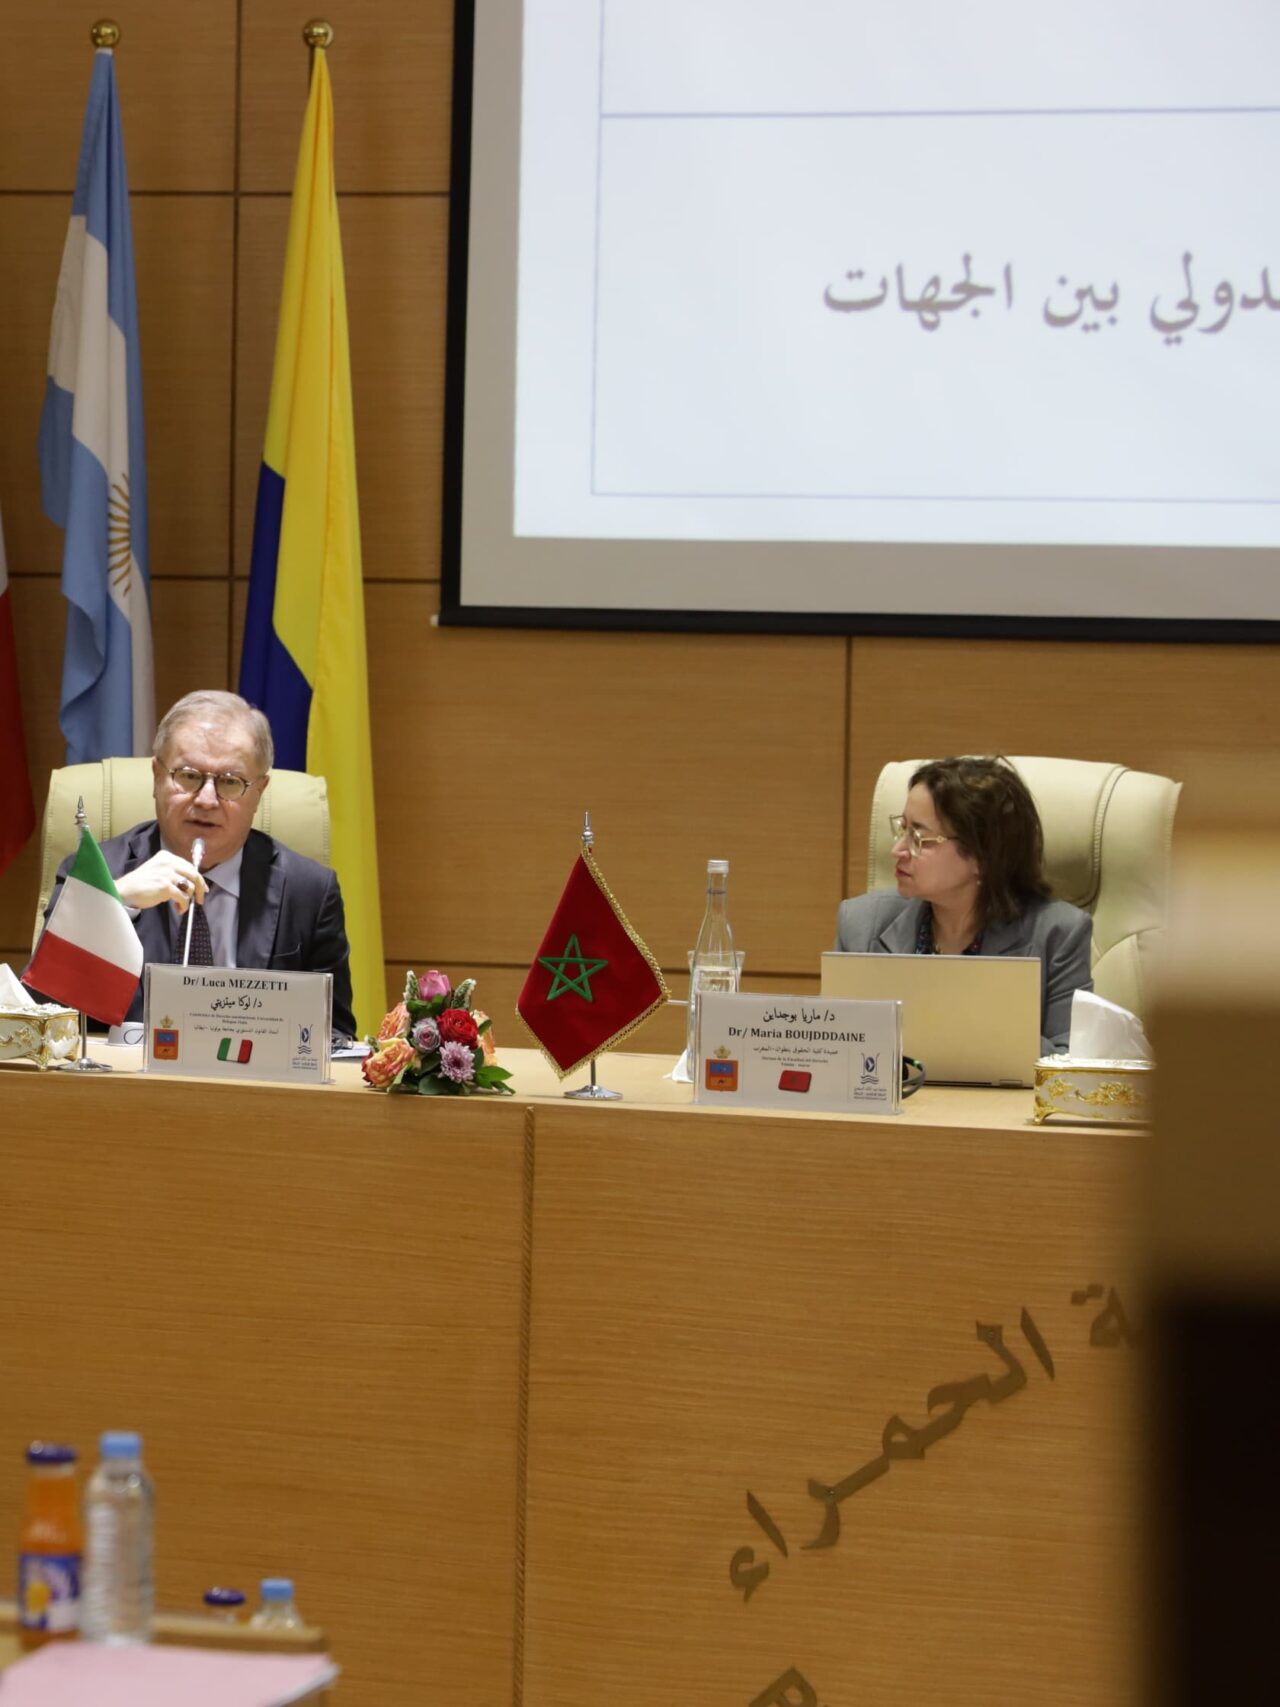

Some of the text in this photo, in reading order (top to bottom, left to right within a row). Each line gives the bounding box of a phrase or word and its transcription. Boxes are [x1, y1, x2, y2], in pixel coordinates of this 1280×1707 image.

[822, 251, 1280, 346] دولي بين الجهات
[183, 975, 288, 992] Dr/ Luca MEZZETTI
[238, 994, 251, 1011] لوكا
[762, 1007, 797, 1023] بوجداين
[801, 1007, 821, 1024] ماريا
[728, 1026, 866, 1043] Dr/ Maria BOUJDDDAINE
[729, 1305, 1056, 1604] الحمراء
